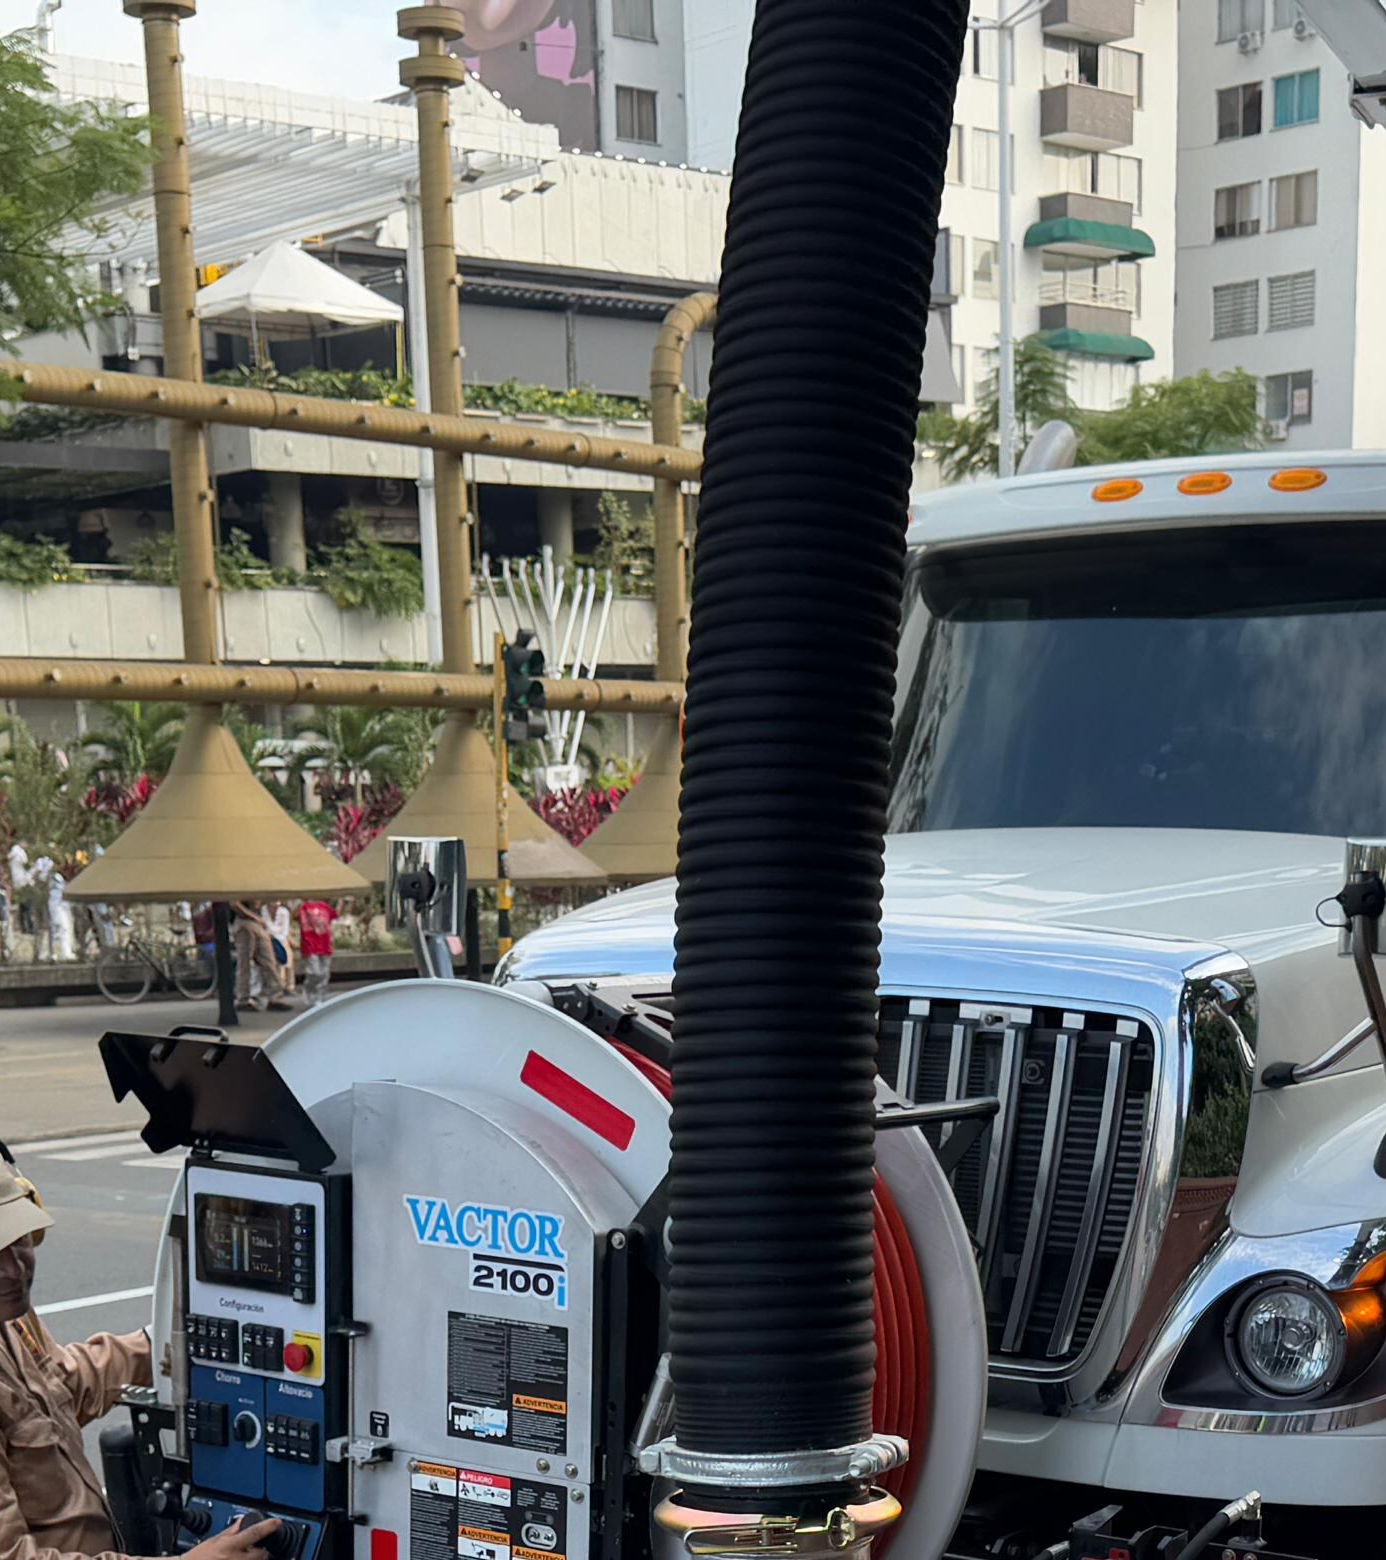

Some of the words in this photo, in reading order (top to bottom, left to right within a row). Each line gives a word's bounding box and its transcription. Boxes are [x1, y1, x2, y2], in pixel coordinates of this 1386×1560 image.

[405, 1196, 565, 1259] VACTOR
[472, 1264, 566, 1307] 2100i
[522, 1398, 564, 1411] ADVERTENCIA
[466, 1473, 493, 1485] PELIGRO
[466, 1529, 509, 1543] ADVERTENCIA
